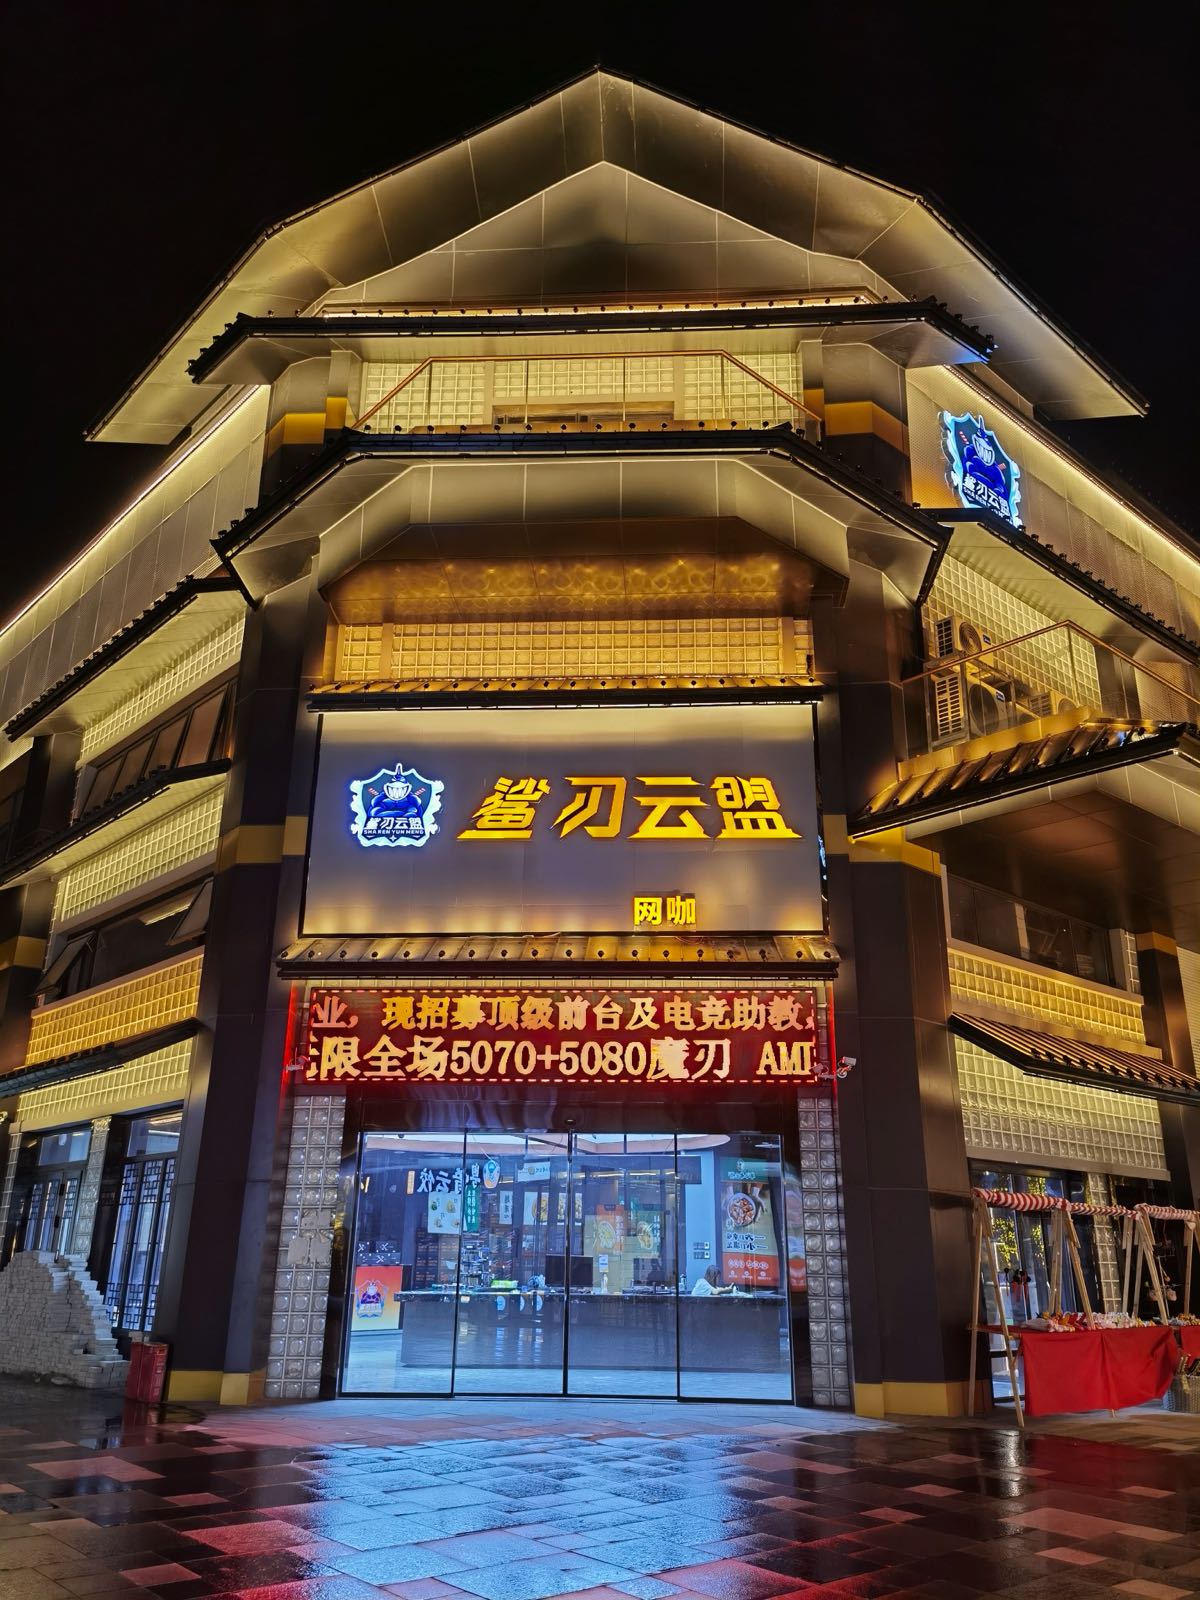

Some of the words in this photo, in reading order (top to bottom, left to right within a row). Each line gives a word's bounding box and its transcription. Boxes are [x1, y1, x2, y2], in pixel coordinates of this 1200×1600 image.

[456, 776, 803, 839] 鲨刃云盟
[362, 817, 425, 830] 鲨刃云盟
[633, 895, 697, 926] 网咖
